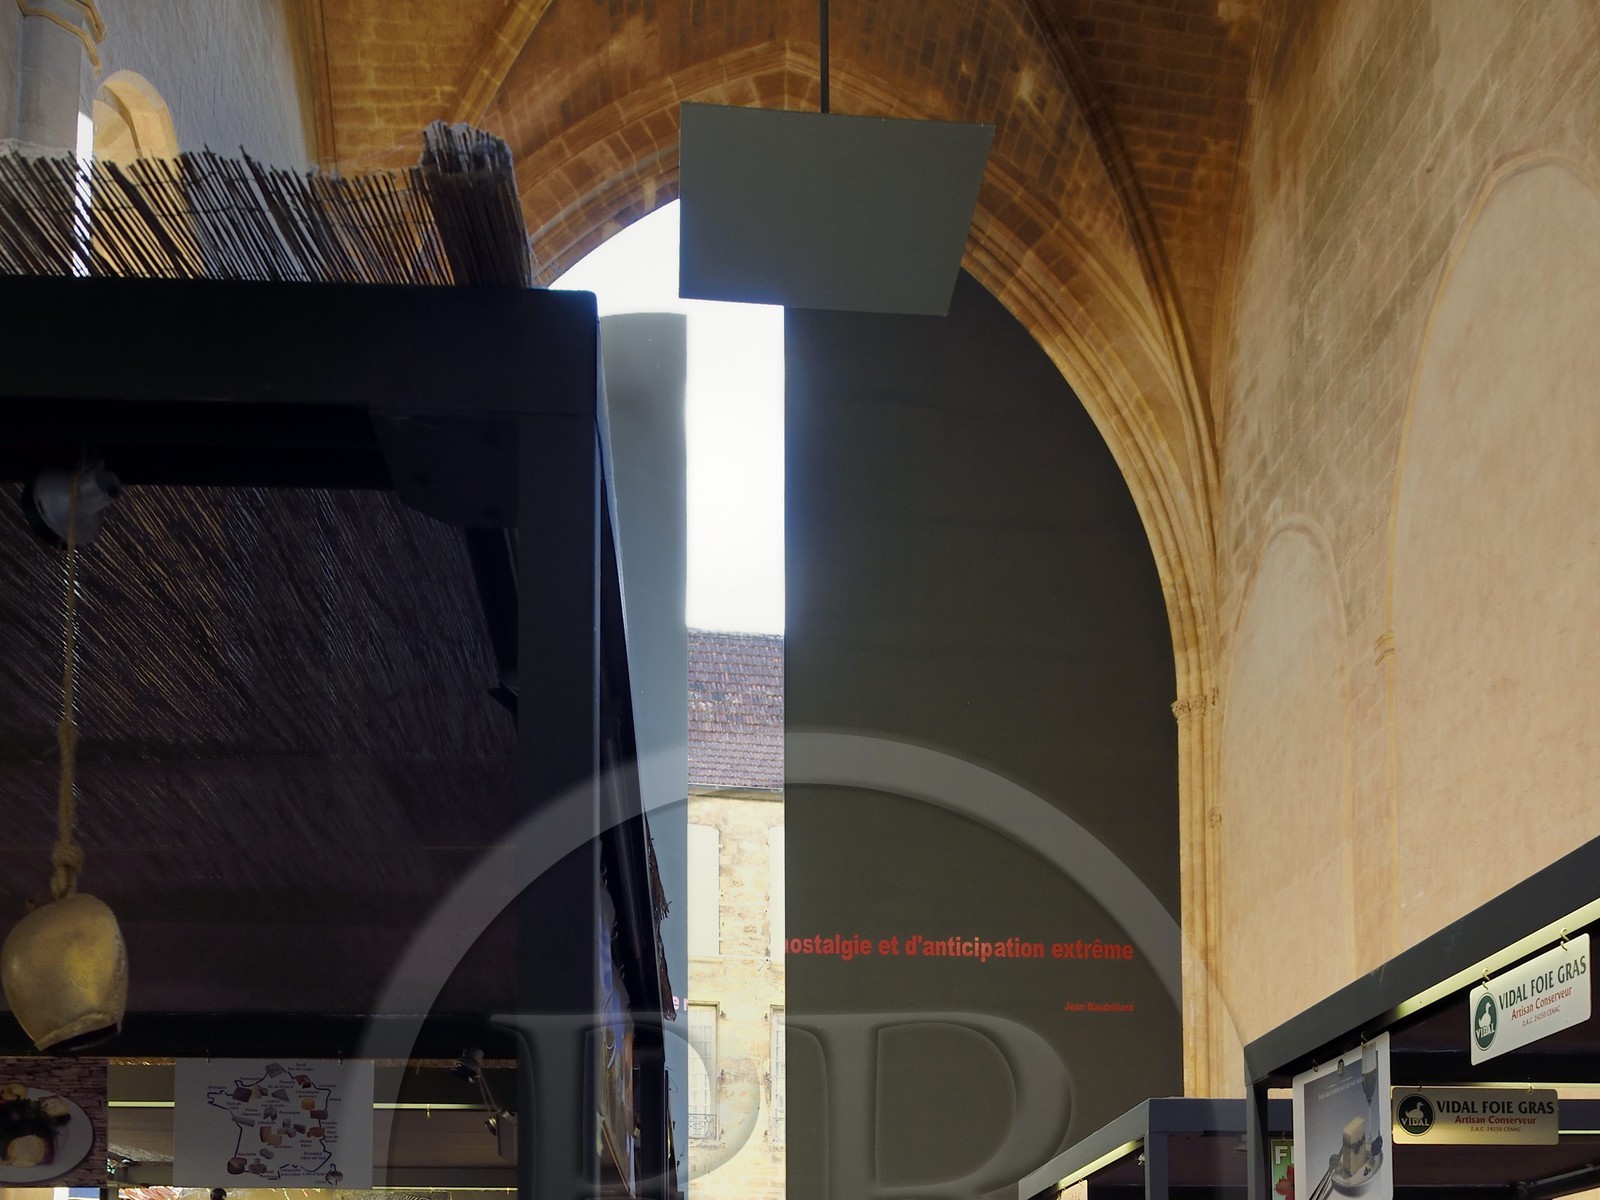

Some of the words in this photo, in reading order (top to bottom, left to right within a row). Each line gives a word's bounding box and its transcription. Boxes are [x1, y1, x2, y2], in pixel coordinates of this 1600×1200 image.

[878, 935, 899, 956] et
[905, 935, 1045, 963] d'anticipation
[1051, 938, 1134, 960] extrême
[1498, 983, 1528, 1011] VIDAL
[1530, 970, 1555, 997] FOIE
[1557, 955, 1587, 984] GRAS
[1064, 1002, 1086, 1012] Jean
[1087, 1001, 1135, 1012] Baudrillard
[1511, 1002, 1534, 1021] Artisan
[1535, 987, 1573, 1010] Conserveur
[1475, 1022, 1496, 1041] VIDAL
[1436, 1100, 1478, 1114] VIDAL
[1482, 1100, 1514, 1114] FOIE
[1518, 1101, 1555, 1115] GRAS
[1401, 1117, 1430, 1127] VIDAL
[1454, 1115, 1486, 1124] Artisan
[1488, 1115, 1537, 1125] Conserveur
